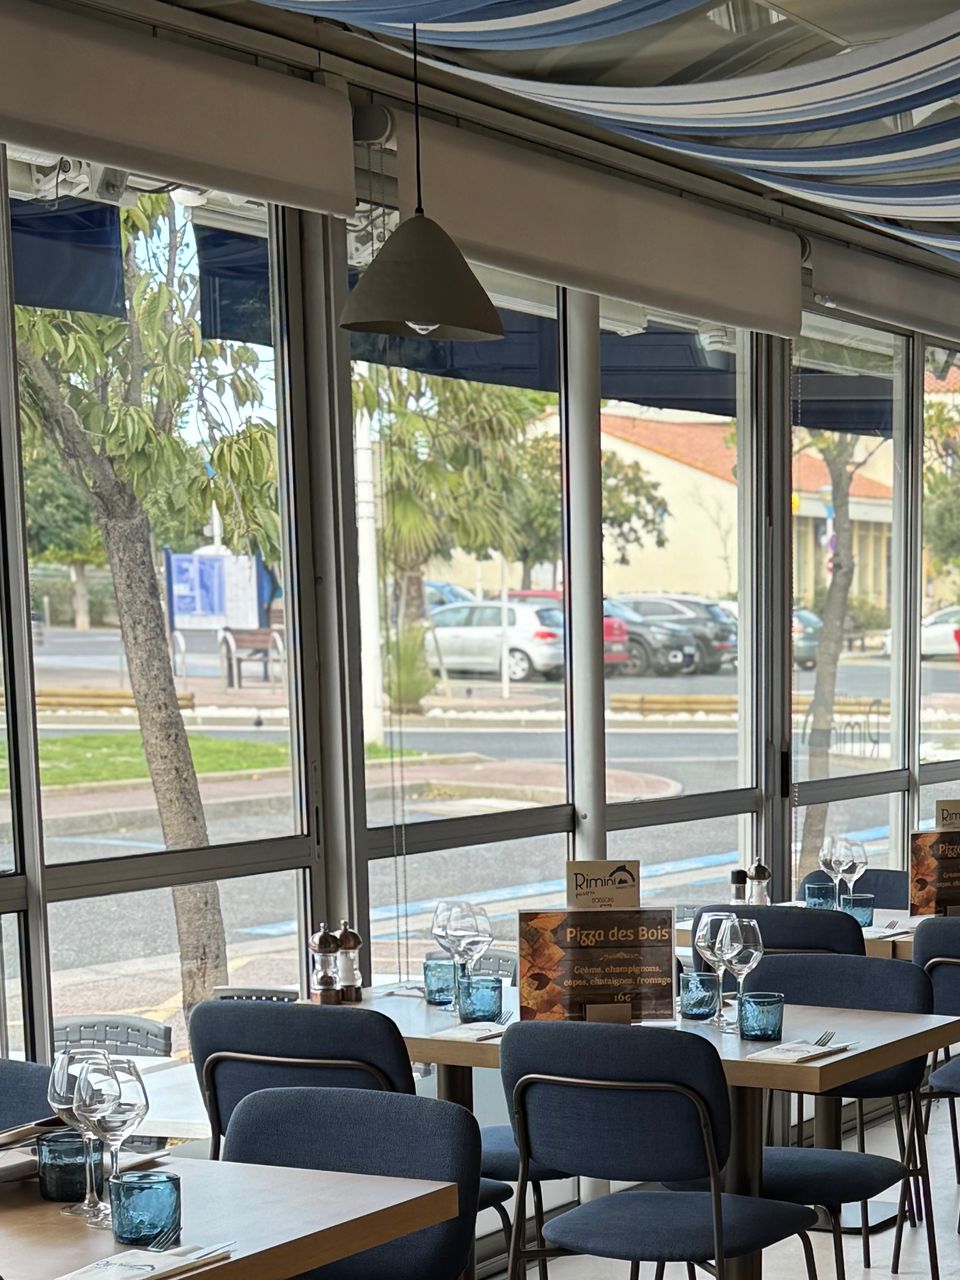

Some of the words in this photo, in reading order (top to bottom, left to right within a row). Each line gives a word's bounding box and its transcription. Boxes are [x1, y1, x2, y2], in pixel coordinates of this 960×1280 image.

[573, 872, 617, 890] Rimini
[566, 927, 604, 946] Pizza
[608, 926, 634, 941] des
[638, 925, 669, 941] Bois
